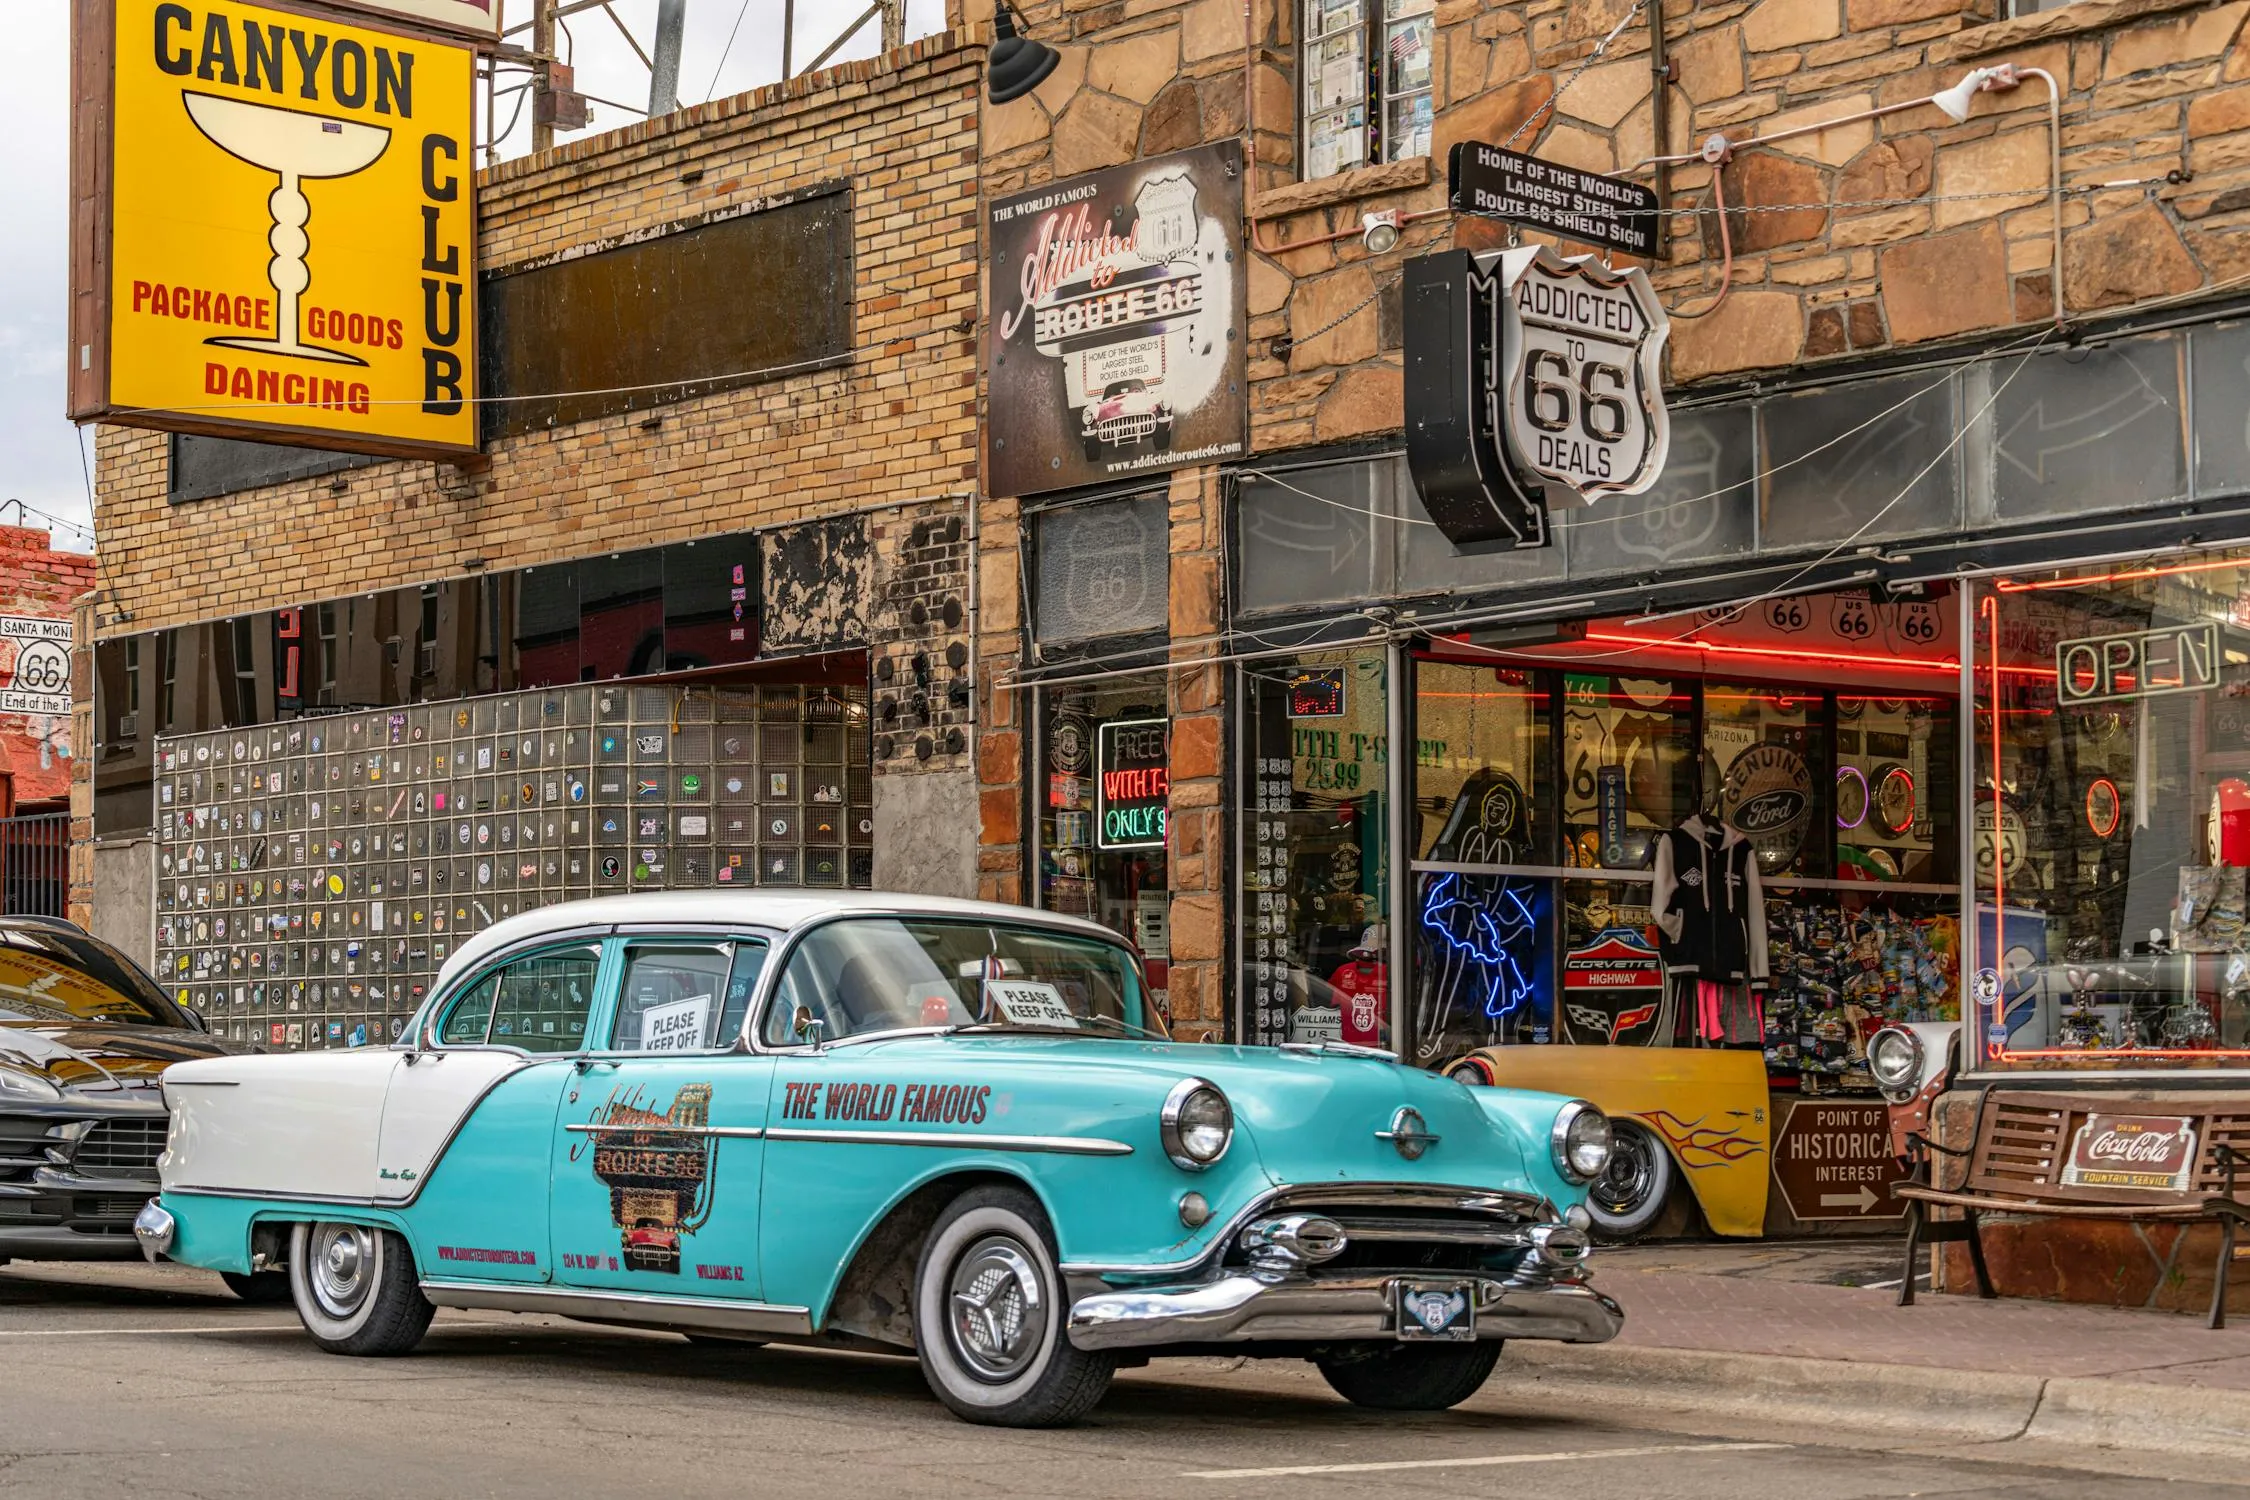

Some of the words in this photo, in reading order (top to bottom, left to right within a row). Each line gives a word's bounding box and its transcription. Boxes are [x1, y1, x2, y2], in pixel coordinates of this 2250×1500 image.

[154, 2, 415, 119] CANYON
[1478, 147, 1523, 174] HOME
[1526, 163, 1545, 180] OF
[1548, 169, 1576, 189] THE
[1580, 175, 1644, 206] WORLD'S
[993, 207, 1014, 222] THE
[1015, 196, 1053, 216] WORLD
[1054, 184, 1097, 206] FAMOUS
[1505, 176, 1570, 208] LARGEST
[1573, 194, 1618, 220] STEEL
[1475, 189, 1525, 214] ROUTE
[1553, 210, 1606, 237] SHIELD
[1609, 224, 1645, 247] SIGN
[420, 133, 463, 416] CLUB
[1090, 260, 1121, 290] to
[132, 280, 270, 331] PACKAGE
[307, 306, 403, 350] GOODS
[1043, 287, 1145, 340] ROUTE
[1154, 278, 1194, 315] 66
[1519, 280, 1632, 333] ADDICTED
[1088, 349, 1108, 361] HOME
[1108, 348, 1118, 357] OF
[1118, 346, 1129, 356] THE
[1129, 341, 1159, 354] WORLD'S
[1565, 338, 1585, 361] TO
[1099, 370, 1119, 381] ROUTE
[1128, 364, 1149, 376] SHIELD
[1102, 359, 1128, 370] LARGEST
[1128, 356, 1145, 365] STEEL
[204, 362, 371, 415] DANCING
[1524, 348, 1631, 443] 66
[1107, 442, 1242, 473] www.addictedtoroute66.com
[1538, 435, 1611, 478] DEALS
[1773, 605, 1803, 628] 66
[1845, 601, 1862, 611] US
[1911, 605, 1928, 614] US
[4, 621, 38, 635] SANTA
[1839, 613, 1868, 635] 66
[1905, 616, 1934, 638] 66
[26, 654, 59, 687] 66
[2065, 629, 2211, 697] OPEN
[5, 694, 26, 708] End
[29, 696, 39, 709] of
[42, 699, 59, 710] the
[1579, 682, 1595, 704] 66
[1115, 730, 1161, 760] FREE
[1707, 728, 1748, 744] ARIZONA
[1104, 769, 1148, 800] WITH
[1725, 745, 1808, 804] GENUINE
[1606, 774, 1617, 842] GARAGE
[1747, 793, 1791, 828] Ford
[1105, 806, 1155, 838] ONLY
[1755, 829, 1798, 850] ARTS
[1568, 959, 1657, 969] CORVETTE
[1588, 973, 1637, 985] HIGHWAY
[1004, 990, 1053, 1005] PLEASE
[653, 1010, 695, 1037] PLEASE
[1008, 1004, 1041, 1018] KEEP
[1044, 1006, 1067, 1021] OFF
[1297, 1014, 1342, 1025] WILLIAMS
[1356, 1015, 1369, 1028] 66
[677, 1028, 698, 1049] OFF
[783, 1082, 823, 1119] THE
[825, 1082, 897, 1121] WORLD
[899, 1084, 991, 1124] FAMOUS
[1817, 1110, 1858, 1126] POINT
[1864, 1110, 1881, 1126] OF
[1816, 1165, 1883, 1181] INTEREST
[2084, 1172, 2129, 1183] FOUNTAIN
[2131, 1175, 2169, 1186] SERVICE
[563, 1253, 575, 1268] 124
[696, 1264, 733, 1280] WILLIAMS
[734, 1266, 744, 1281] AZ
